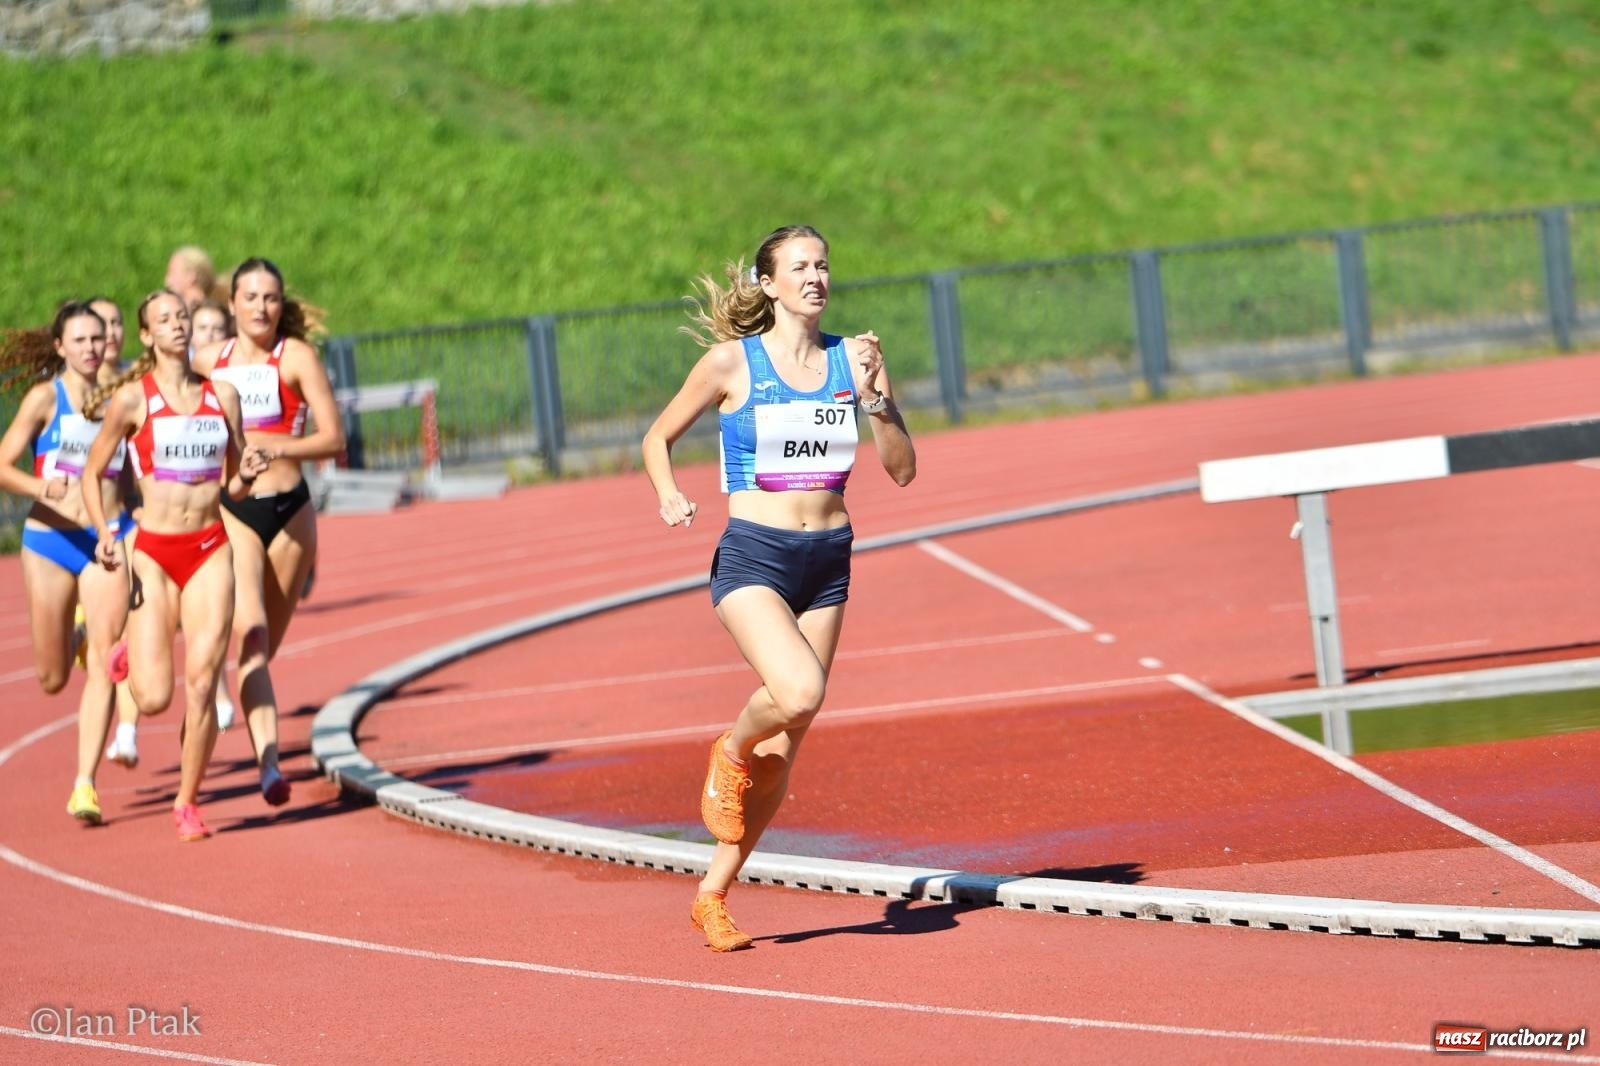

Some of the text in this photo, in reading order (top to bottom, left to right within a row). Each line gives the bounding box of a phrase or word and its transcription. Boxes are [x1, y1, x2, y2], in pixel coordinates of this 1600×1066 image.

[238, 393, 270, 407] MAY
[814, 408, 846, 425] 507
[196, 420, 220, 432] 208
[165, 444, 217, 458] FELBER
[783, 440, 829, 458] BAN
